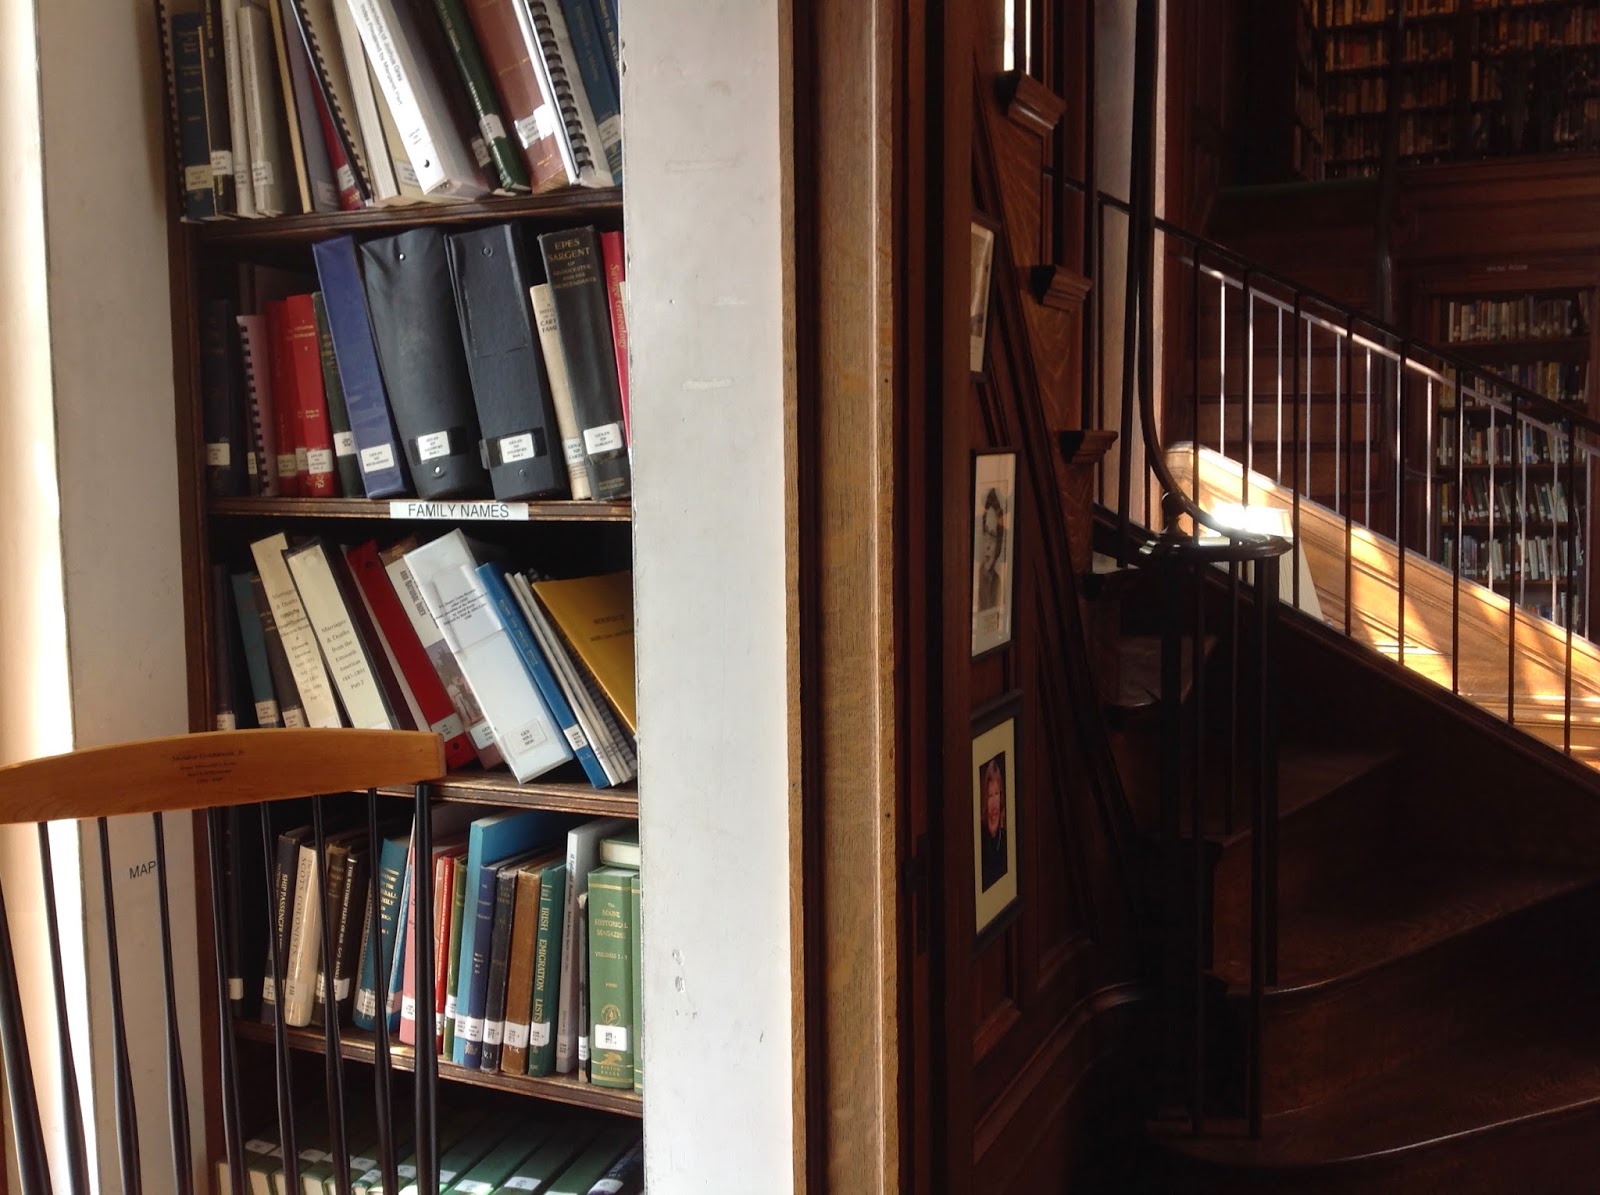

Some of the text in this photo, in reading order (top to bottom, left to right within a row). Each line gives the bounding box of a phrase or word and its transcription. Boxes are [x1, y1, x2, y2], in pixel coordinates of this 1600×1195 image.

[383, 41, 396, 66] Joshua
[393, 64, 404, 82] Gray
[555, 238, 580, 250] EPES
[548, 247, 590, 262] SARGENT
[611, 262, 627, 350] Savage Genealogy
[408, 503, 509, 518] FAMILY NAMES
[399, 570, 428, 617] AND NATIONAL INDEX
[321, 620, 346, 633] Marriages
[332, 630, 350, 640] Deaths
[332, 644, 344, 653] from
[335, 650, 357, 662] Ellsworth
[340, 660, 361, 671] American
[129, 860, 156, 880] MAP
[278, 891, 286, 933] PASSENGER
[292, 857, 307, 954] SCOTS COLONISTS
[601, 909, 621, 918] MAINE
[594, 918, 628, 929] HISTORICAL
[596, 928, 626, 939] MAGAZINE
[534, 907, 549, 1021] IRISH EMIGRATION LISTS
